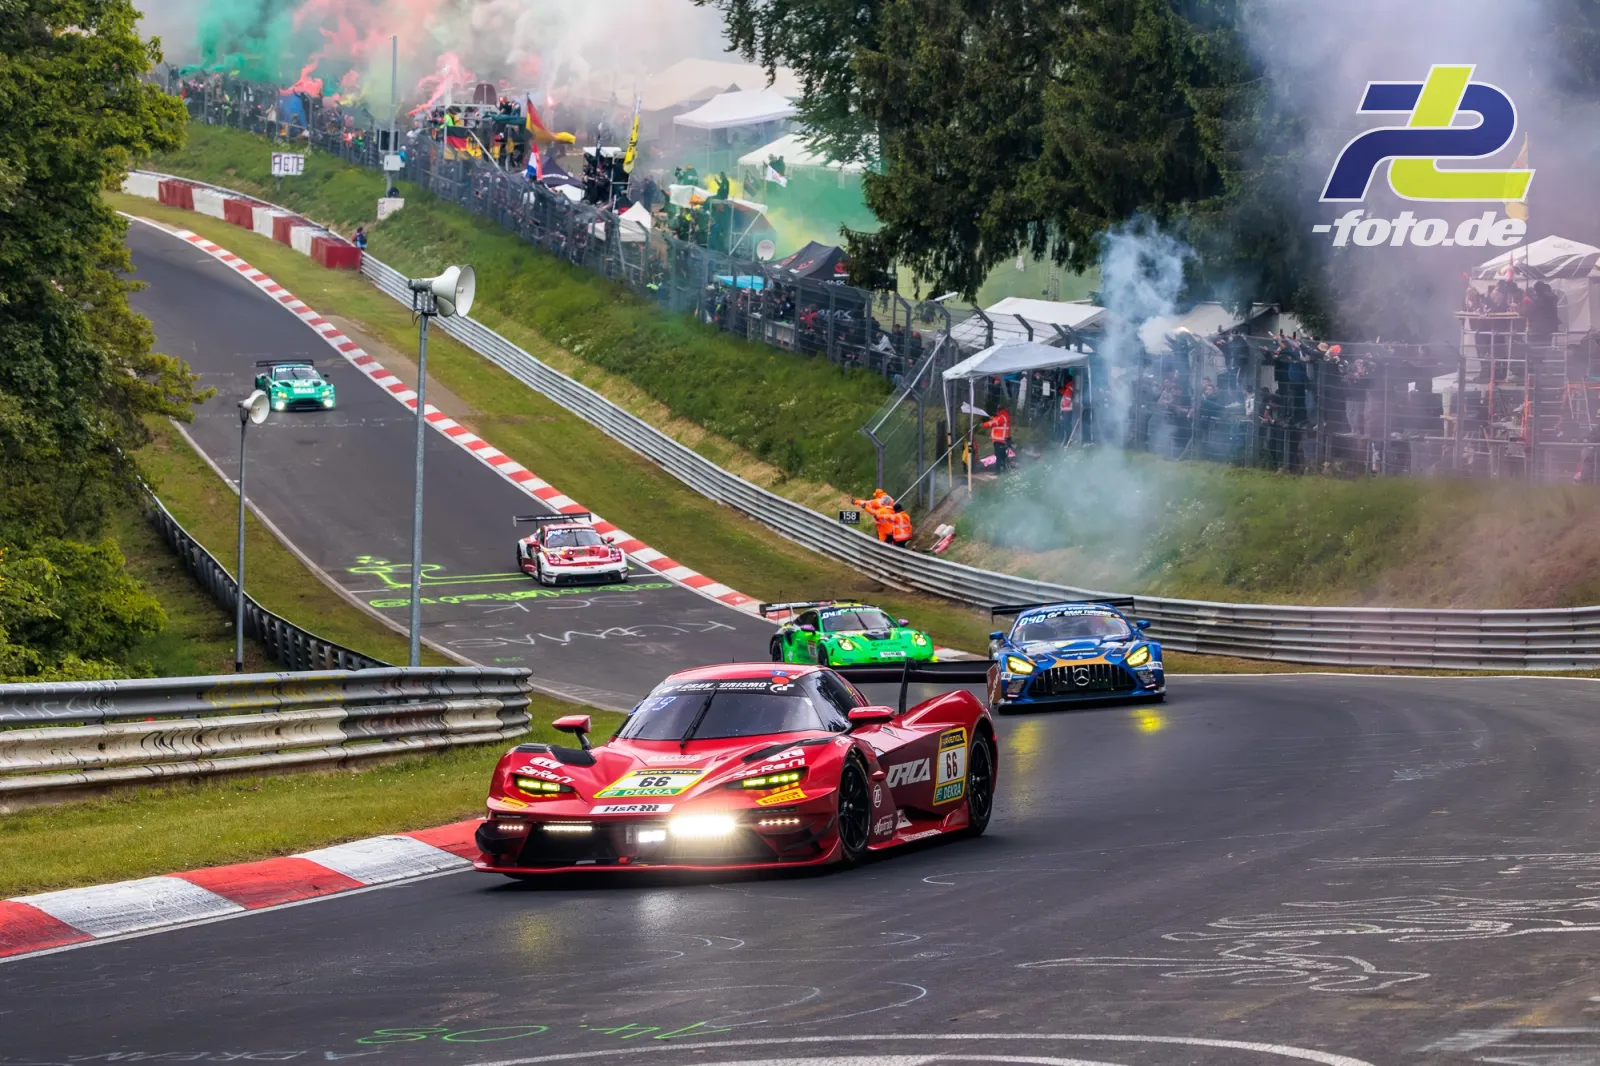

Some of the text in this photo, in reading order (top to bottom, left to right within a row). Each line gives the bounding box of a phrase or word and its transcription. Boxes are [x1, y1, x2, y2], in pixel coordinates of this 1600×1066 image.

[842, 511, 857, 521] 158
[1020, 614, 1046, 626] 040
[945, 751, 958, 779] 66
[638, 776, 672, 788] 66
[943, 783, 961, 800] DEKRA
